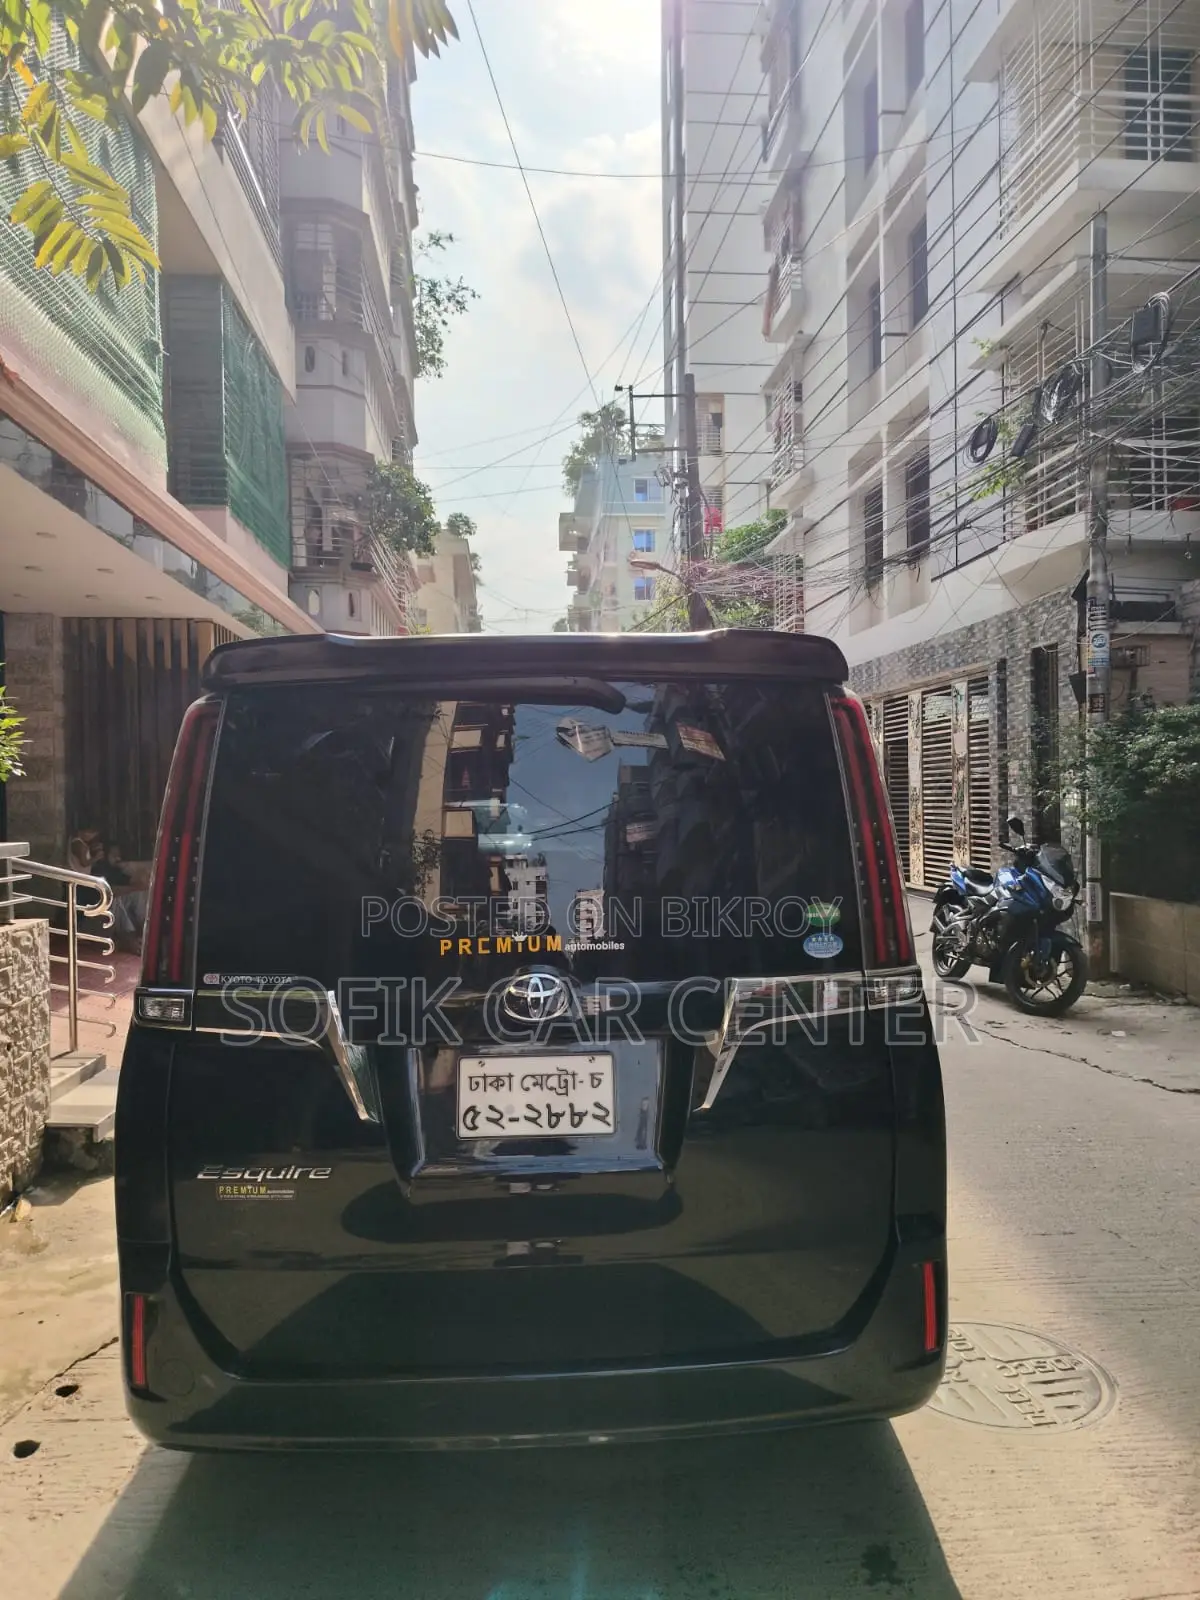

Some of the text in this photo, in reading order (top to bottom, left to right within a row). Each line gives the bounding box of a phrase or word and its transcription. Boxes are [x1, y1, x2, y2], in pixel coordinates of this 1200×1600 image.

[564, 941, 625, 951] automobiles
[221, 975, 292, 984] KYOTO TOYOTA
[468, 1072, 514, 1092] ঢাকা
[462, 1102, 611, 1131] ৫২-২৮৮২
[197, 1165, 332, 1182] Esquire
